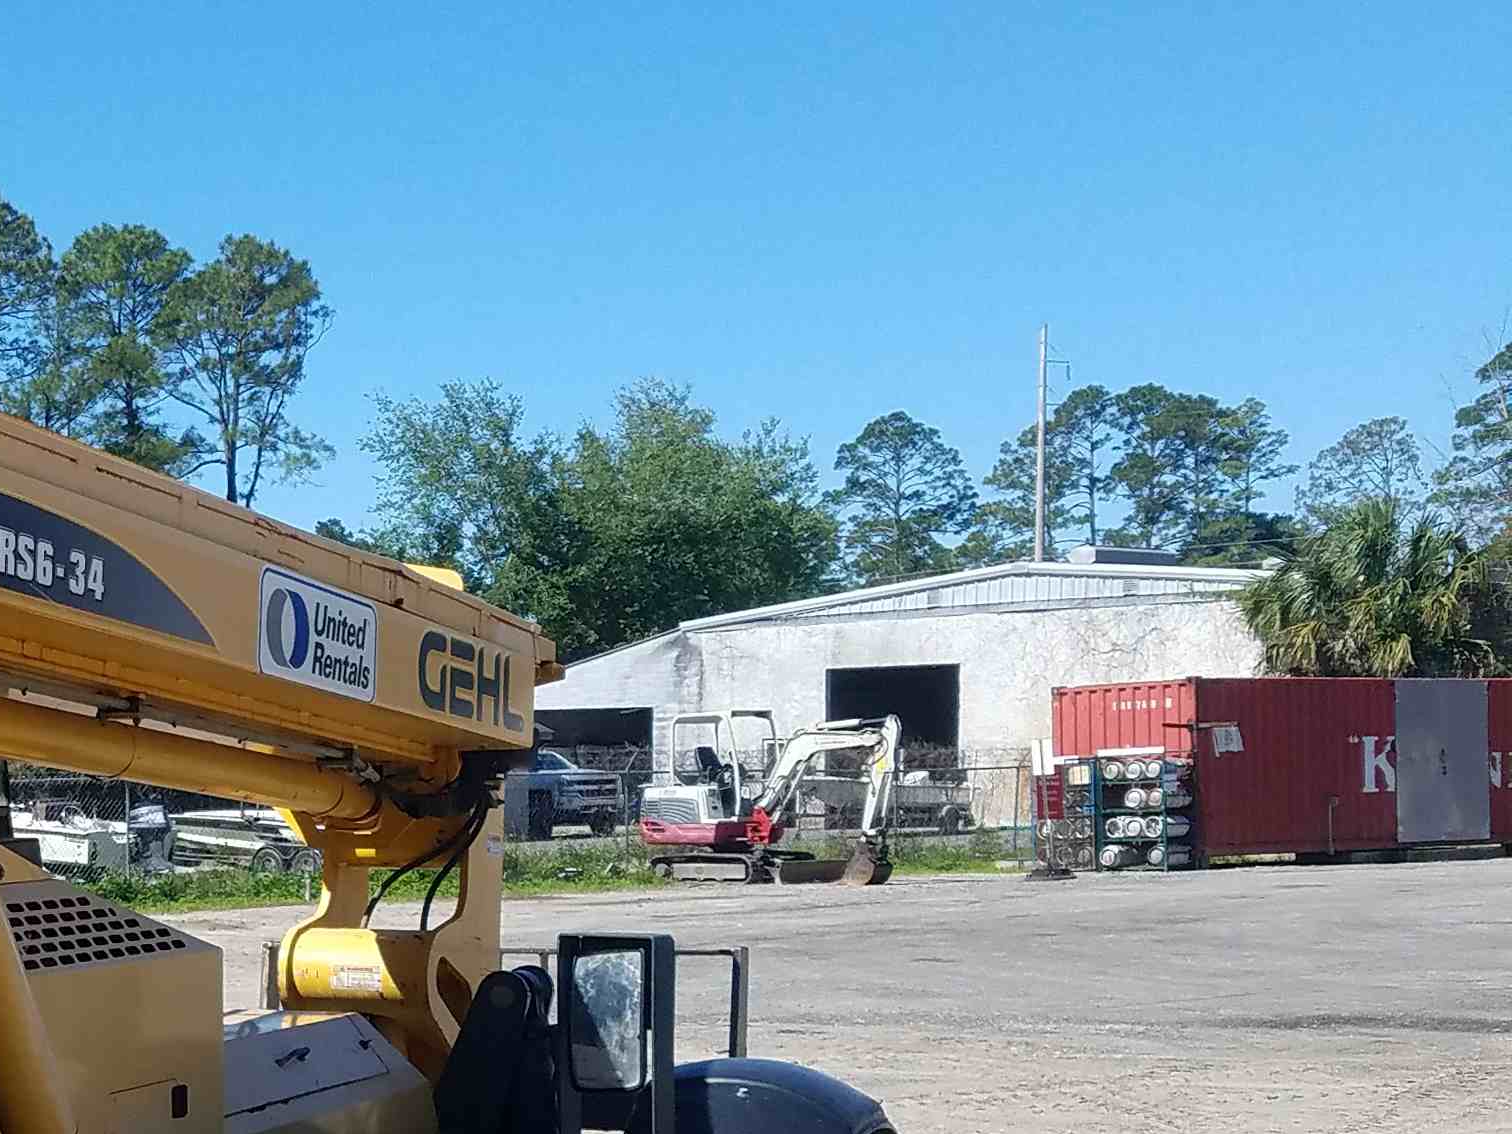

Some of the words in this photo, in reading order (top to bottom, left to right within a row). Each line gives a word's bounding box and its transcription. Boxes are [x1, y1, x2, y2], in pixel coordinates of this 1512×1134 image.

[314, 601, 368, 651] United
[311, 641, 371, 690] Rentals
[418, 630, 524, 733] GEHL
